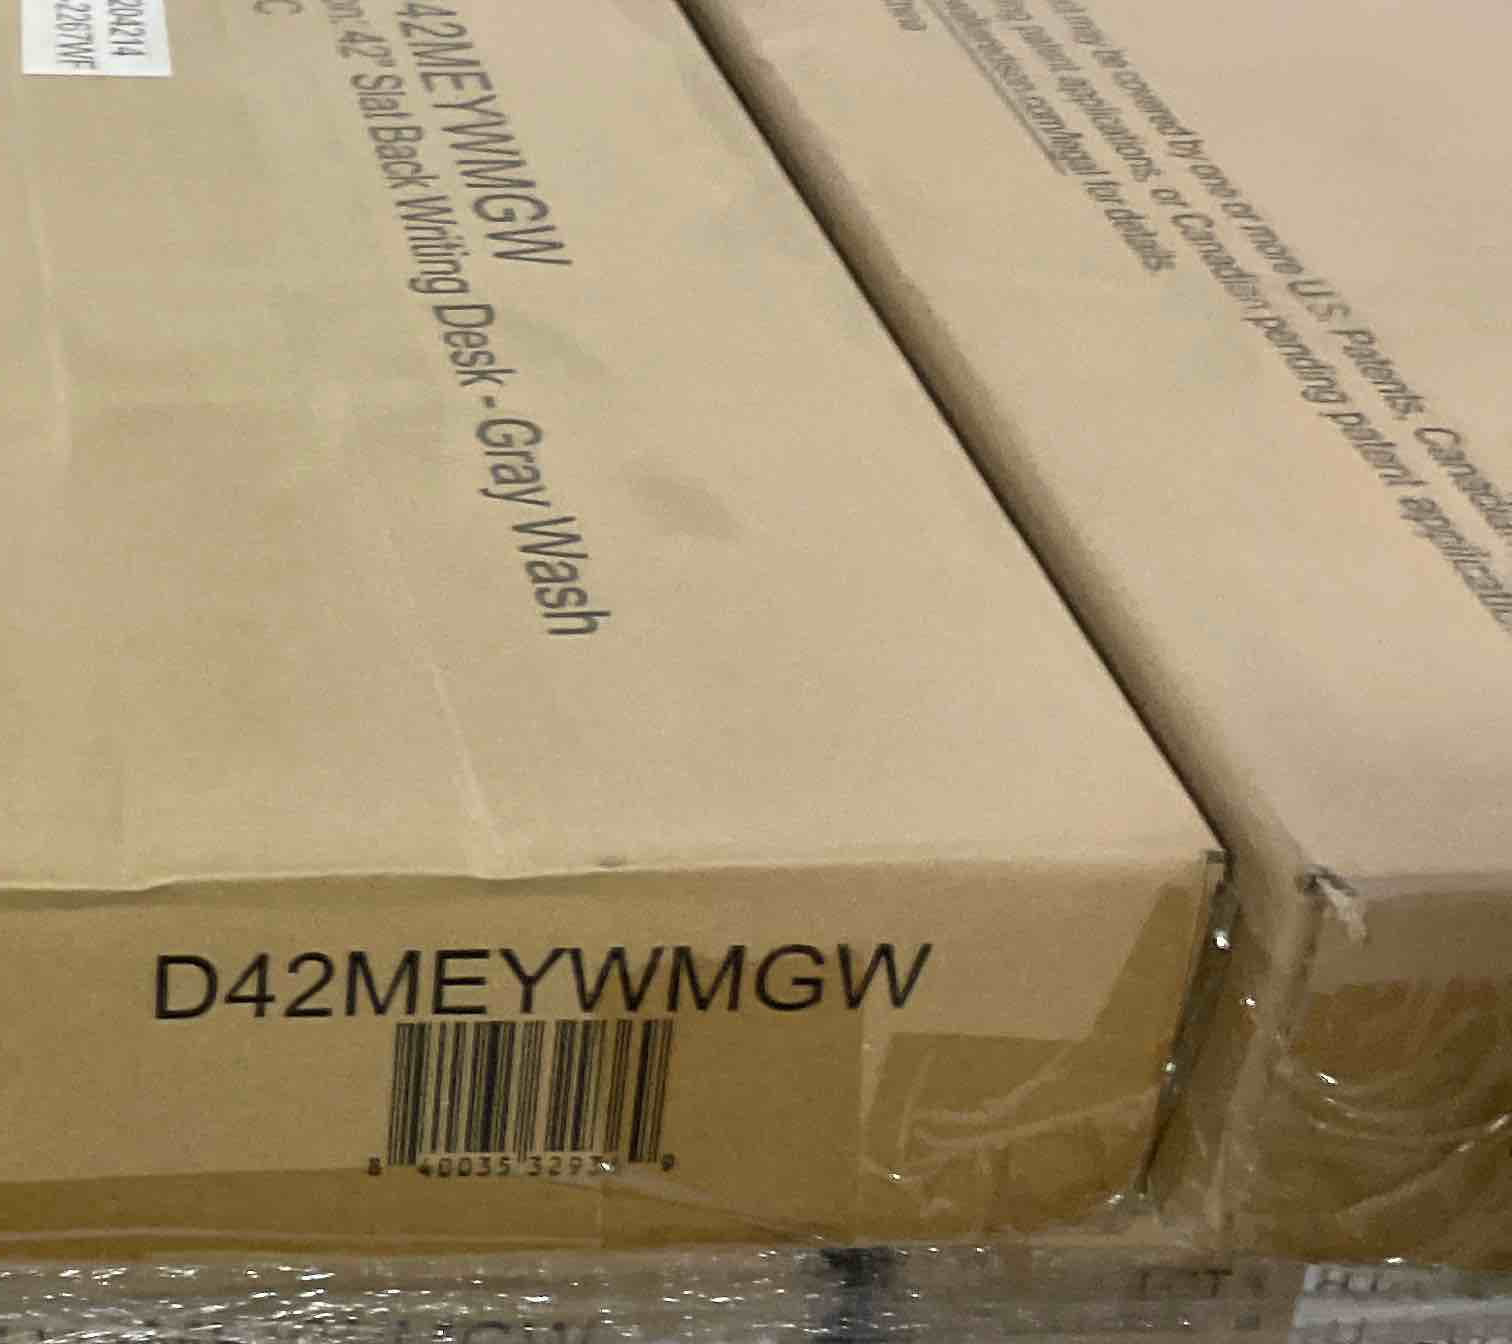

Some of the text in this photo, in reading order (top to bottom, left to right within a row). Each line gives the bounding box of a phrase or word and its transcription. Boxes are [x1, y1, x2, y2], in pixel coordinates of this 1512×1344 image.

[350, 74, 414, 119] Slat
[369, 125, 441, 191] Back
[1081, 181, 1126, 205] for
[1149, 188, 1191, 207] or
[1220, 202, 1263, 221] or
[394, 195, 472, 296] Writing
[1169, 212, 1273, 310] Canadian
[1238, 225, 1305, 274] more
[432, 303, 517, 388] Desk
[1240, 316, 1351, 404] pending
[475, 417, 553, 508] Gray
[1317, 411, 1430, 486] patent
[511, 515, 613, 637] Wash
[154, 943, 932, 1019] D42MEYWMGW
